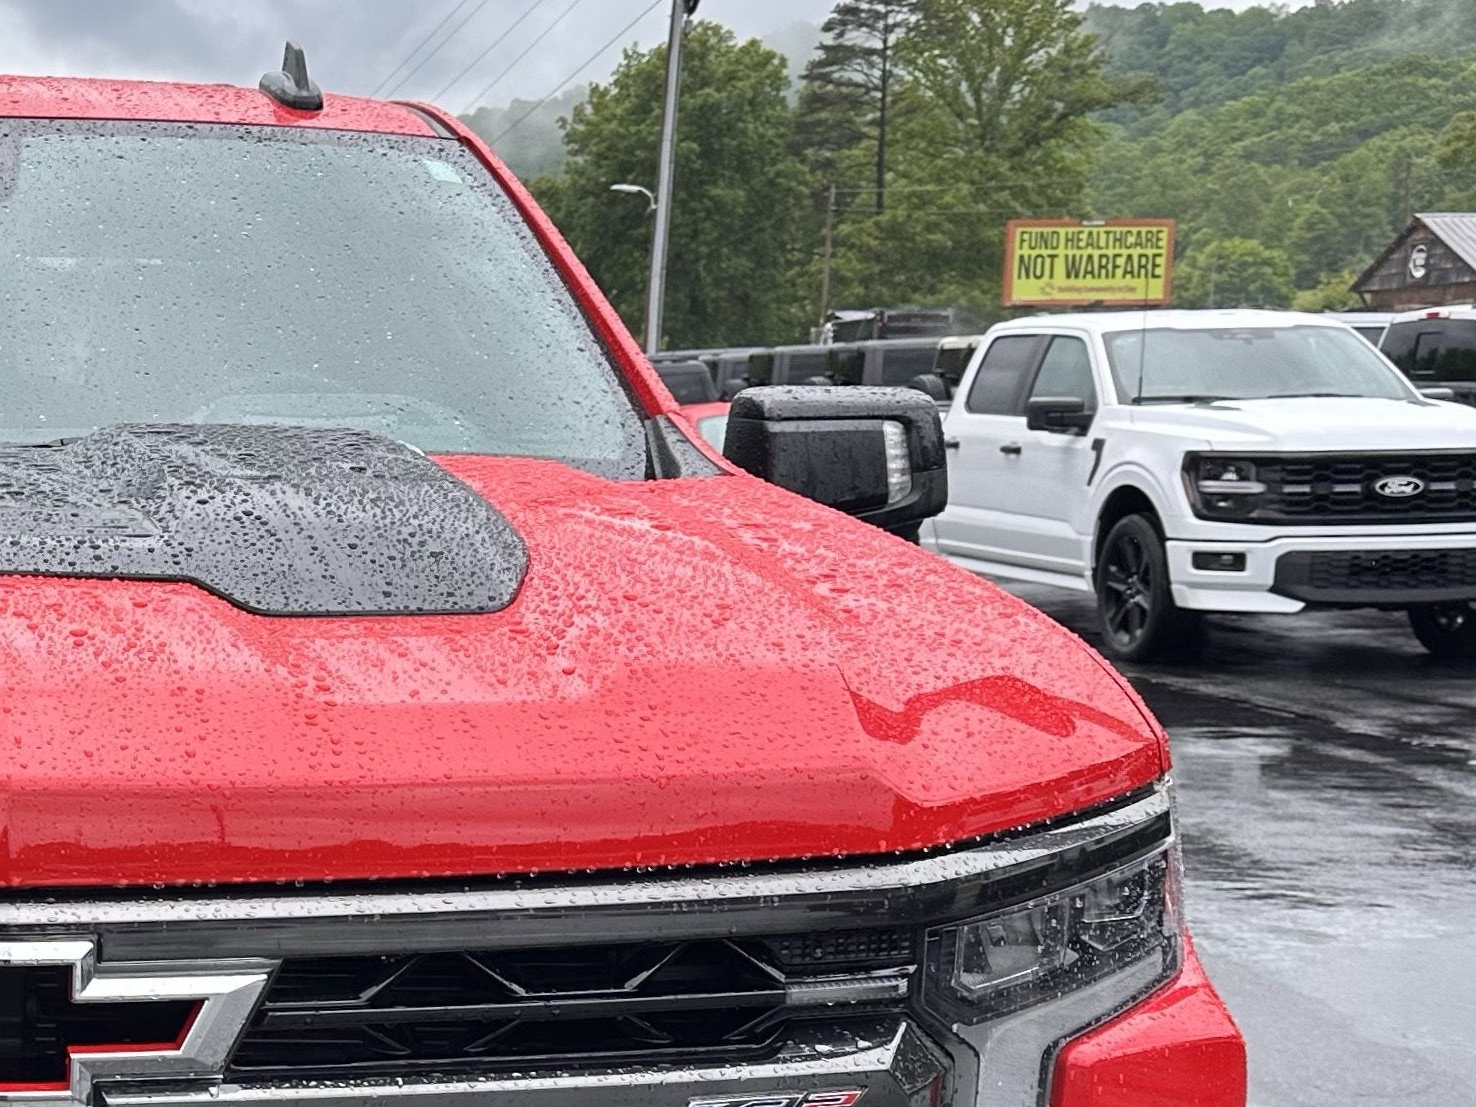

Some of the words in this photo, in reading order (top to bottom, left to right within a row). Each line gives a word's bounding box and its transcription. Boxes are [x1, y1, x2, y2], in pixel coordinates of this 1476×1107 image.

[1019, 230, 1060, 250] FUND
[1065, 229, 1164, 250] HEALTHCARE
[1017, 253, 1059, 280] NOT
[1064, 253, 1164, 280] WARFARE
